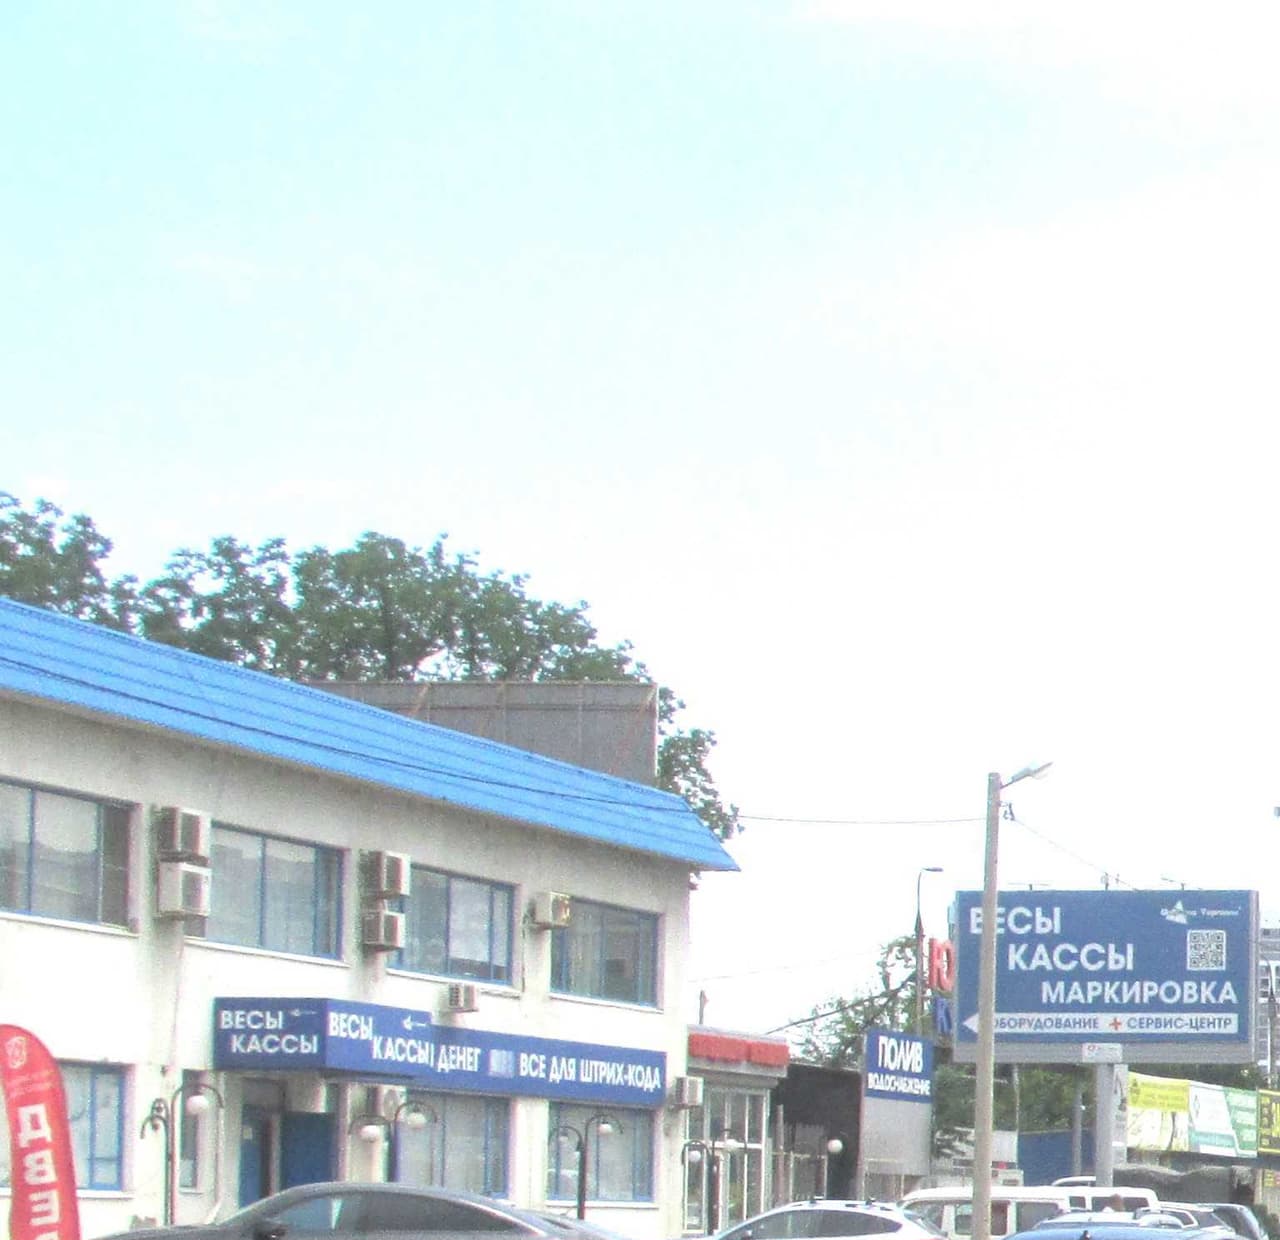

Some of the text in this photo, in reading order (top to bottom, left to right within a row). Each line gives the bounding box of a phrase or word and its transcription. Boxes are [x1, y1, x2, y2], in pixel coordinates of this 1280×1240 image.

[969, 906, 1061, 935] ВЕСЫ
[1007, 942, 1134, 972] КАССЫ
[1040, 980, 1239, 1005] МАРКИРОВКА
[219, 1009, 284, 1030] ВЕСЫ
[327, 1011, 373, 1041] ВЕСЫ
[1127, 1016, 1233, 1032] СЕРВИС-ЦЕНТР
[231, 1034, 319, 1054] КАССЫ
[371, 1035, 430, 1065] КАССЫ
[877, 1034, 924, 1074] ПОЛИВ
[437, 1044, 662, 1092] ДЕНЕГ ВСЕ ДЛЯ ШТРИХ-КОДА
